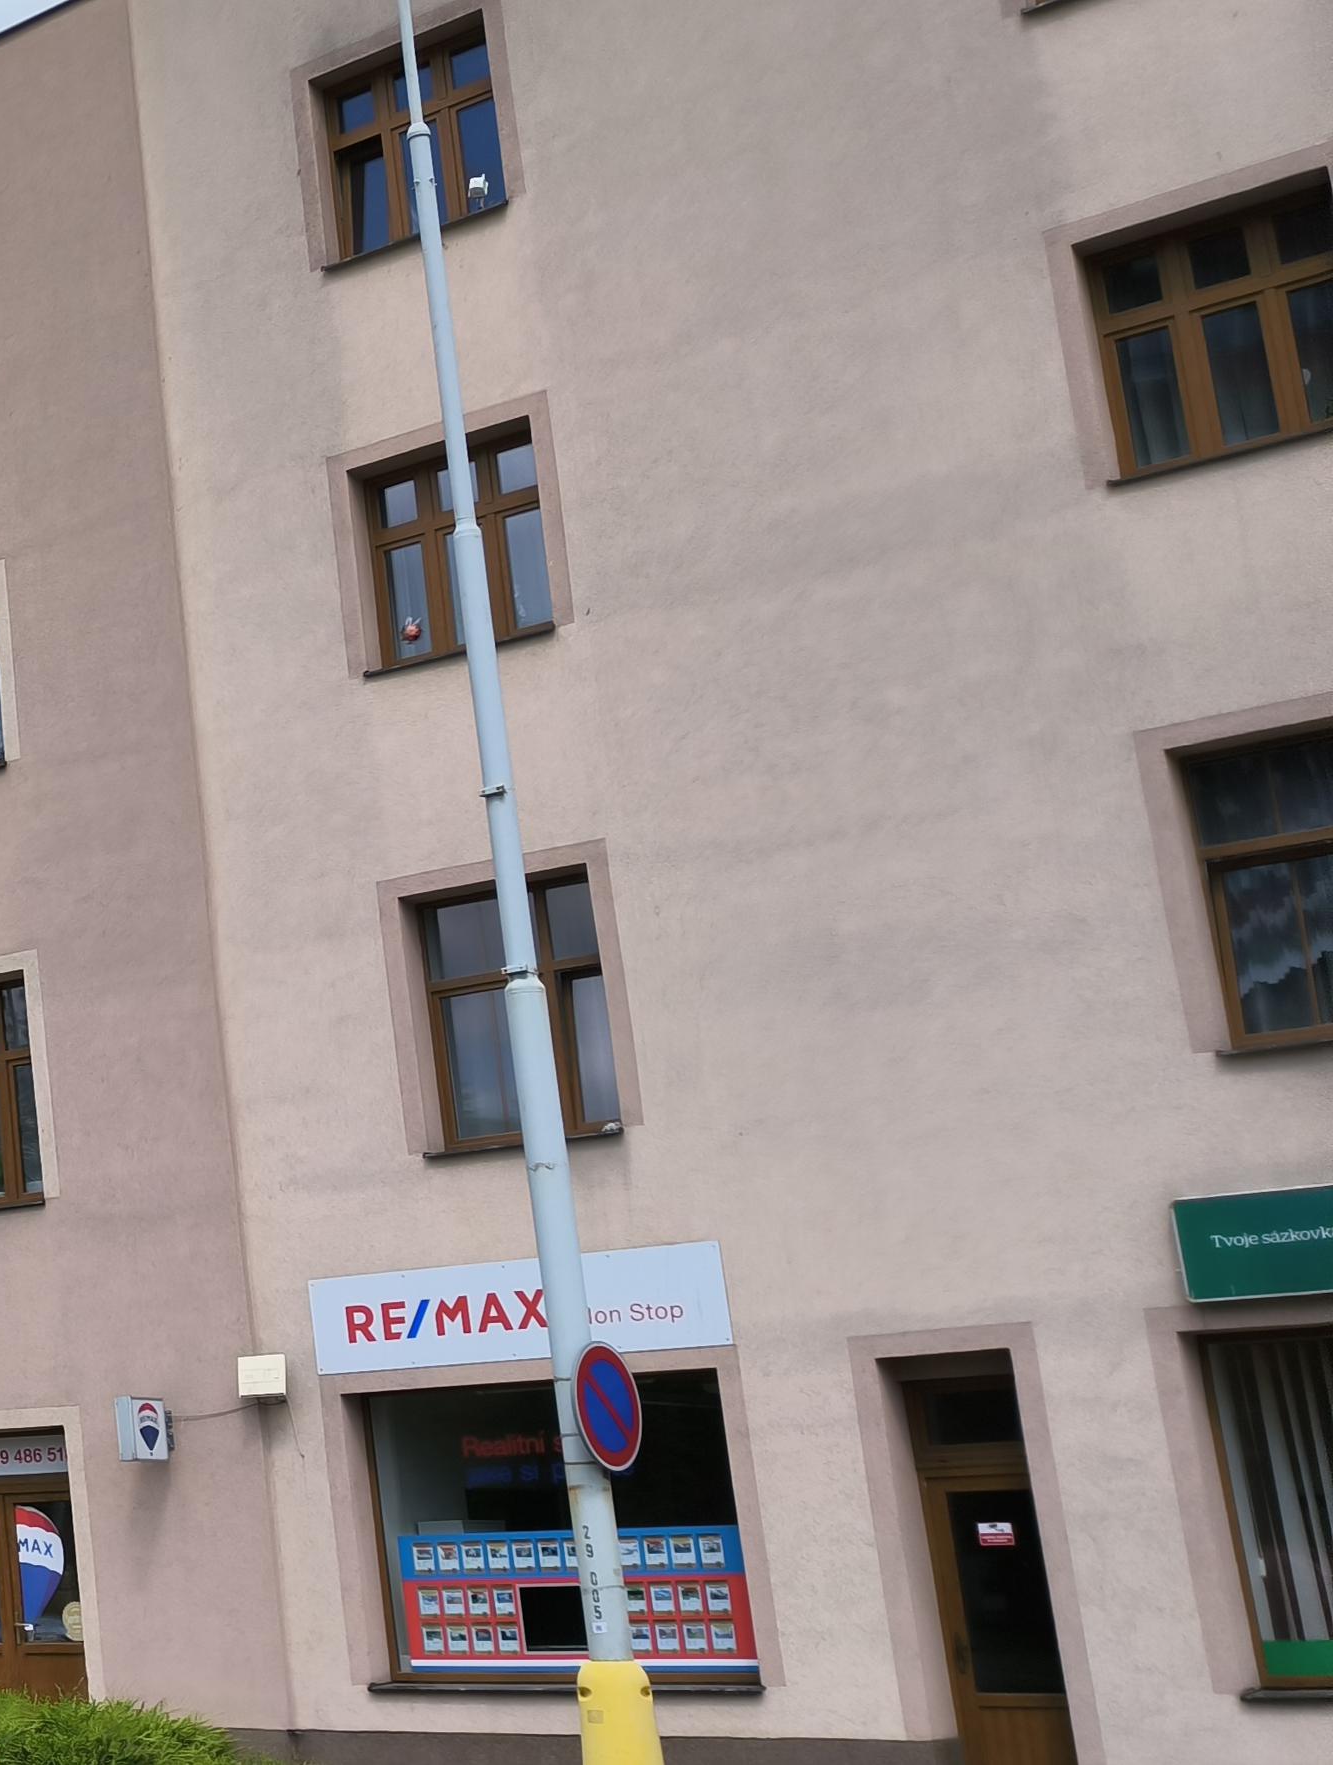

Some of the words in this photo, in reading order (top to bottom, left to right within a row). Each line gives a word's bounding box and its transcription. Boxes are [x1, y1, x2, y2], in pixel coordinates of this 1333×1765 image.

[1210, 1233, 1259, 1248] Tvoje
[345, 1288, 549, 1344] RE/MAX
[629, 1302, 684, 1325] Stop
[14, 1448, 42, 1463] 486
